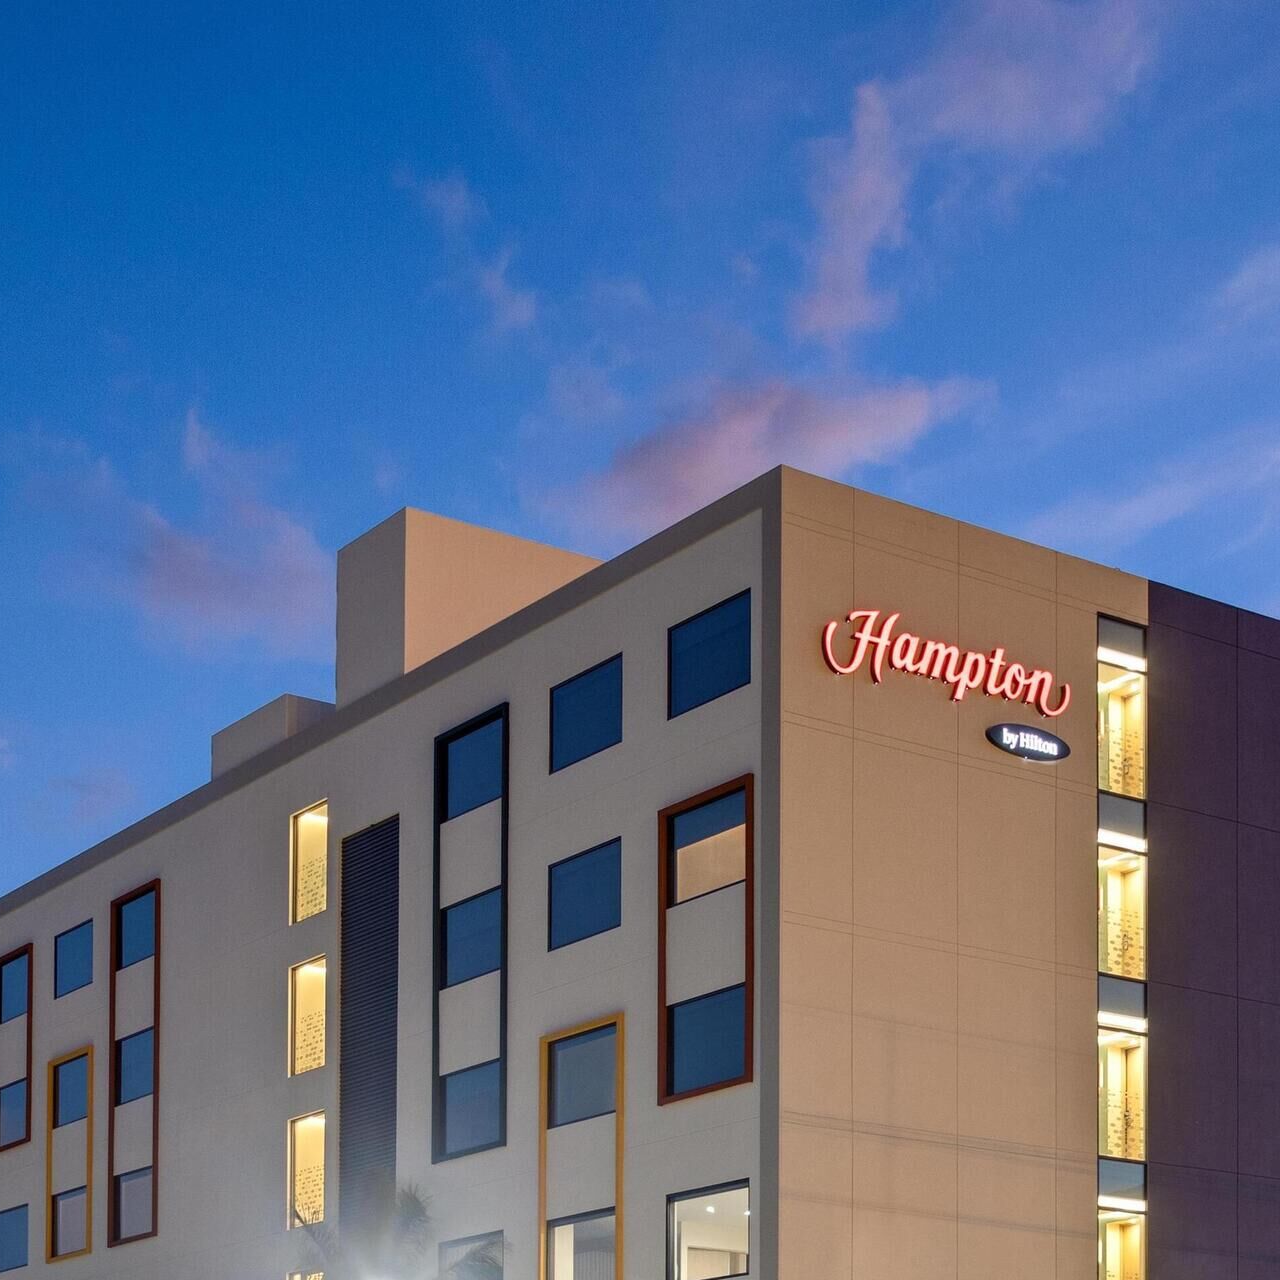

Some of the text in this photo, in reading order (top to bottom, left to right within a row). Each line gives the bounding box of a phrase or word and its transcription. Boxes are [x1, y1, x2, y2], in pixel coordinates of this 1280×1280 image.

[822, 610, 1071, 717] Hampton
[1002, 728, 1058, 755] by Hilton
